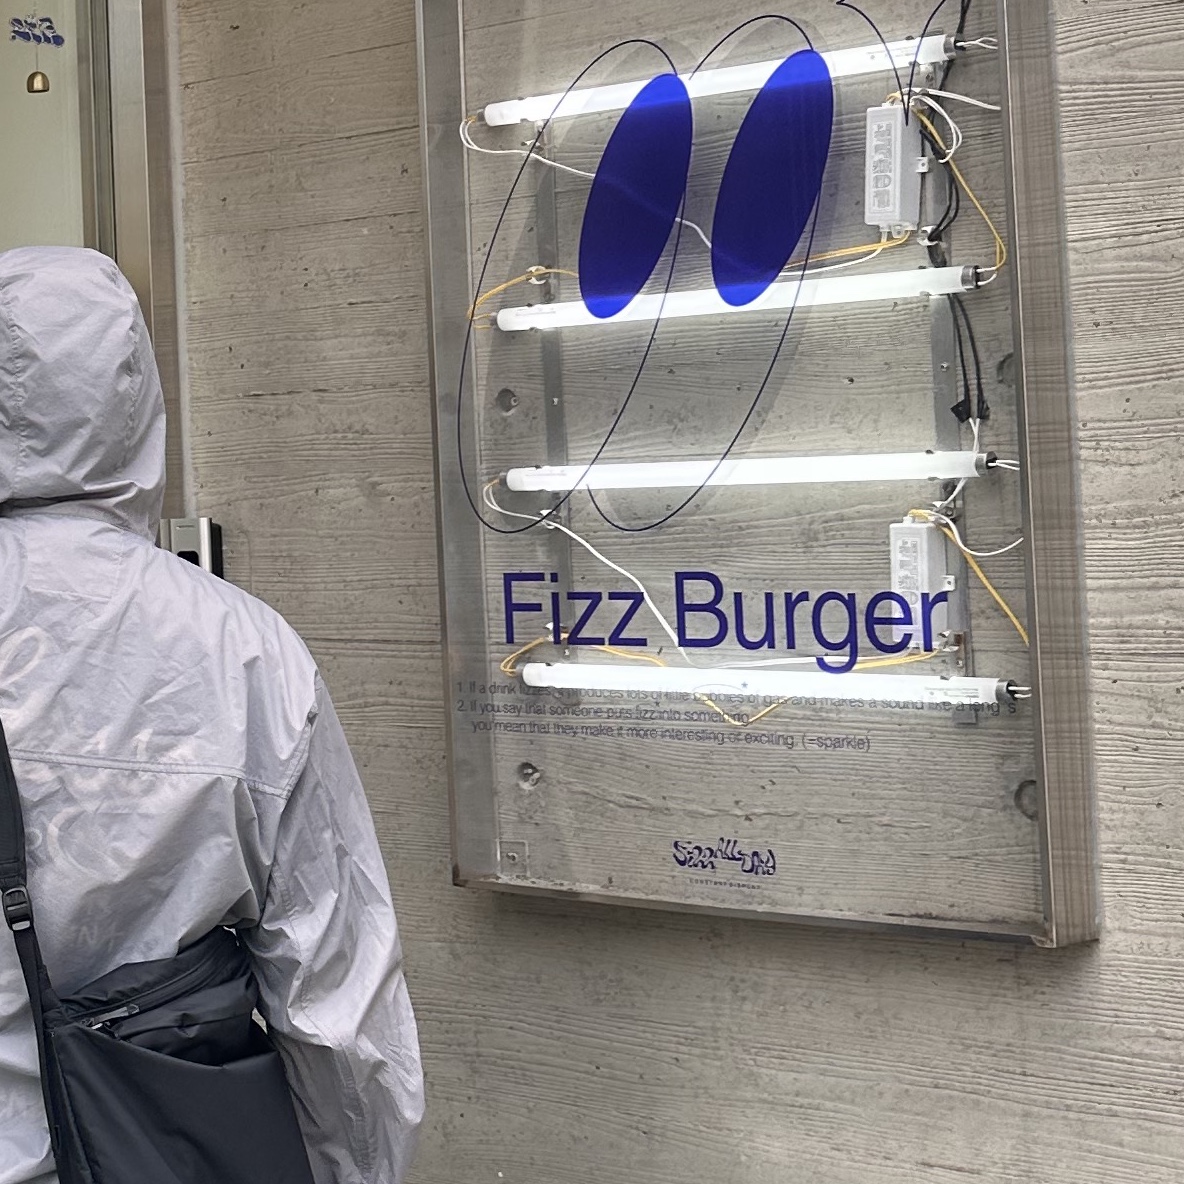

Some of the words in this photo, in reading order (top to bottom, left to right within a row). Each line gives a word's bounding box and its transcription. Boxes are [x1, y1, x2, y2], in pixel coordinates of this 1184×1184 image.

[502, 571, 648, 647] Fizz
[674, 570, 949, 675] Burger
[488, 682, 516, 695] drink
[479, 704, 500, 716] you
[502, 704, 523, 718] say
[525, 702, 548, 715] that
[549, 705, 603, 718] someone
[471, 720, 493, 734] you
[494, 721, 527, 733] mean
[530, 720, 551, 734] that
[580, 723, 615, 737] make
[626, 727, 658, 739] more
